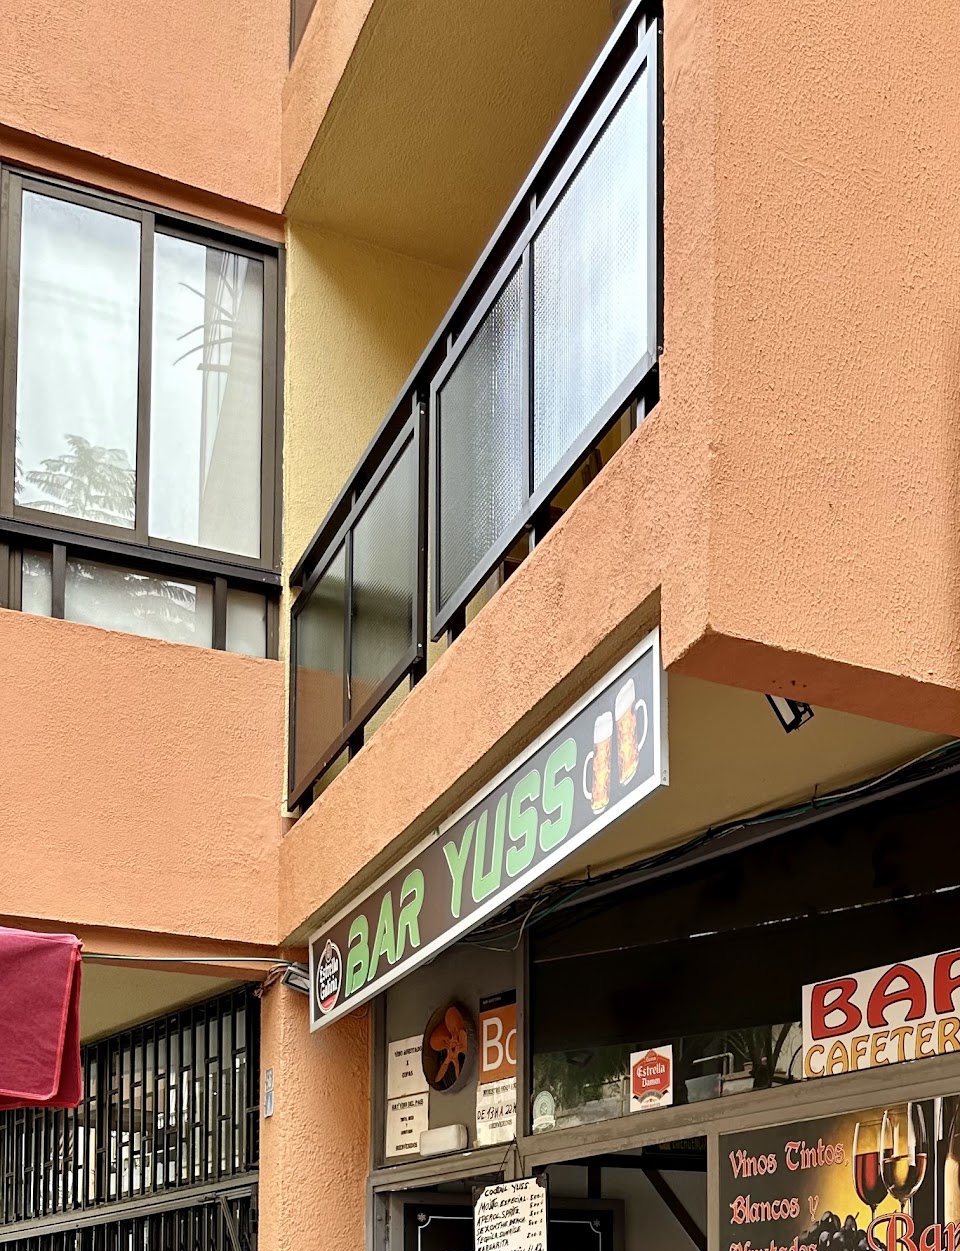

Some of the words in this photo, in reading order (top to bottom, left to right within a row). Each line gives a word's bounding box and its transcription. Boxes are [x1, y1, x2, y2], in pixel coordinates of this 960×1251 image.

[345, 868, 425, 998] BAR
[442, 737, 578, 919] YUSS
[636, 1063, 666, 1078] Estrella
[641, 1077, 661, 1088] Damm
[728, 1149, 777, 1179] Vinos
[730, 1195, 800, 1225] Blancos
[807, 1195, 820, 1222] y
